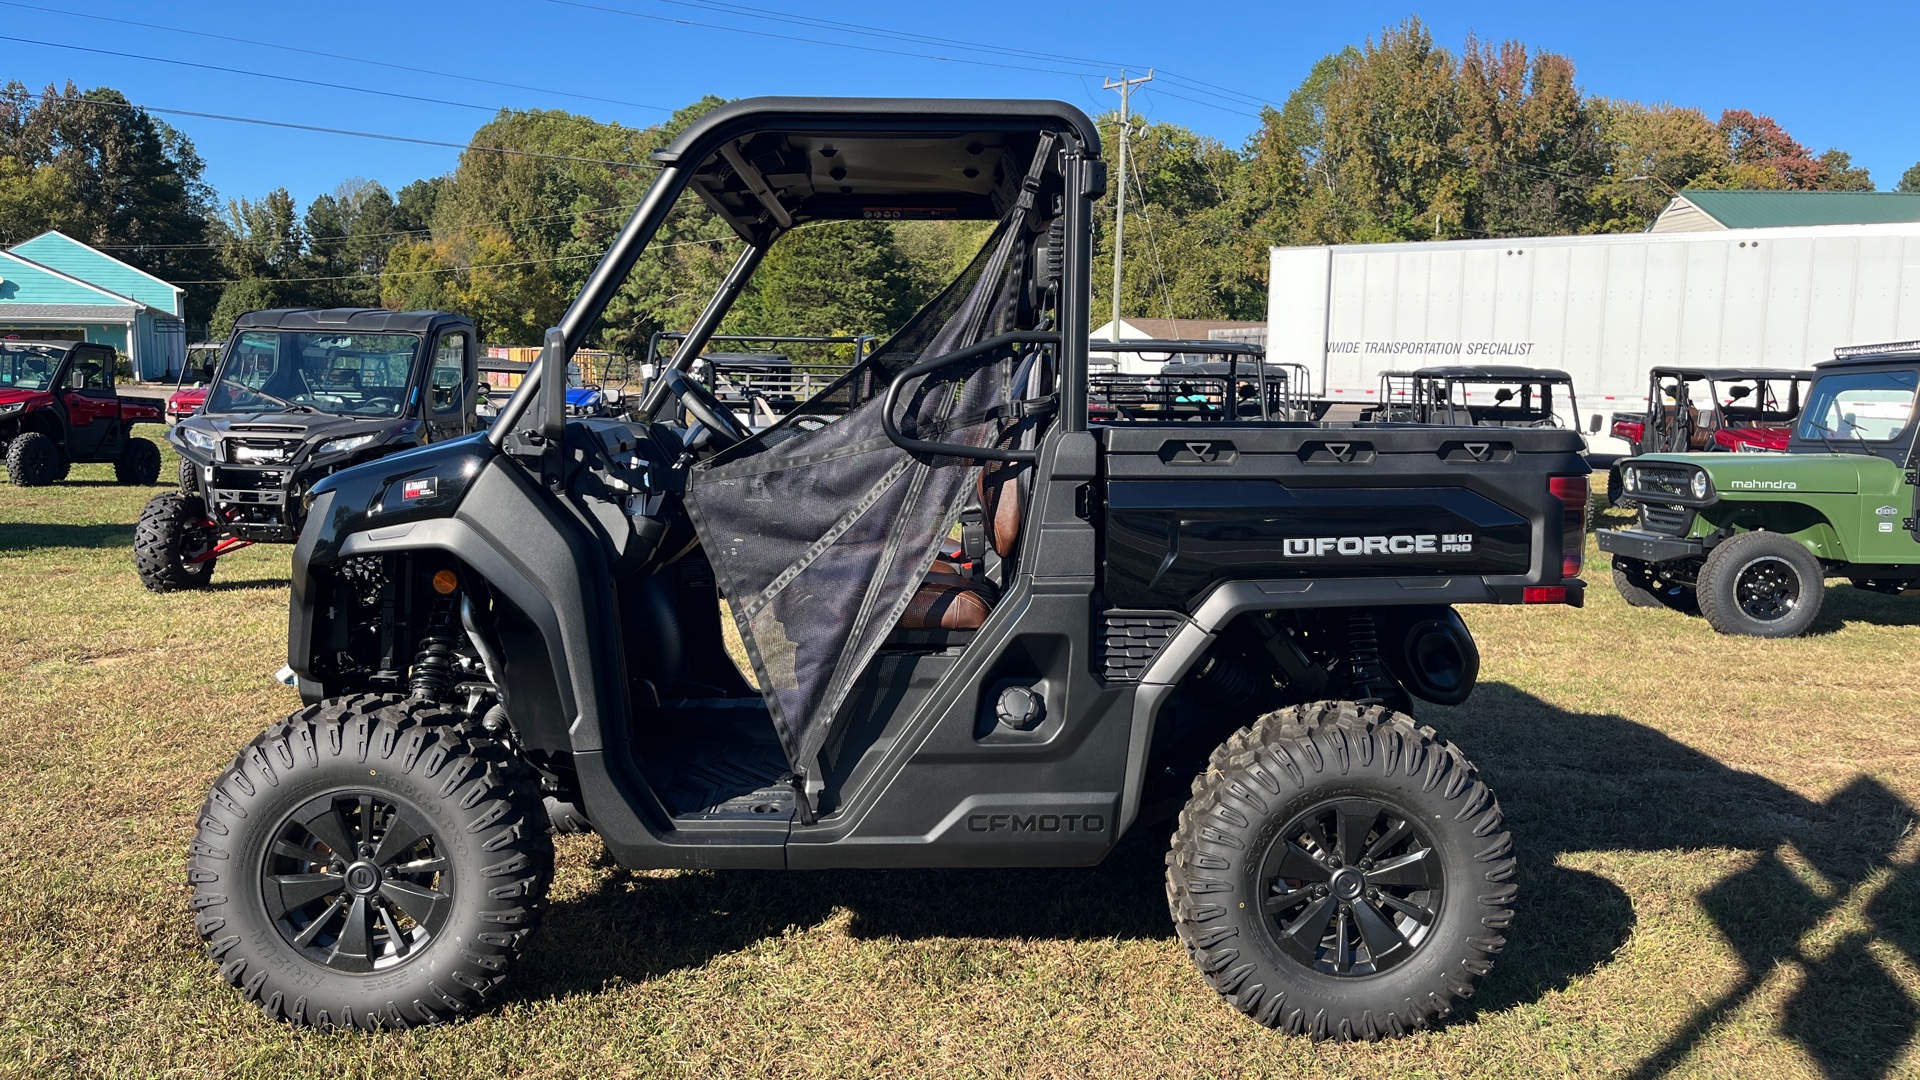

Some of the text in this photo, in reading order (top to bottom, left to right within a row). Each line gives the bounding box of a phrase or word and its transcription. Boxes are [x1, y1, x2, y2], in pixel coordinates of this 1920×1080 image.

[1364, 342, 1463, 354] TRANSPORTATION
[1466, 342, 1535, 355] SPECIALIST
[238, 447, 284, 459] wasaki
[1731, 479, 1797, 489] mahindra
[1283, 534, 1473, 557] UFORCE U10
[1442, 544, 1473, 553] PRO
[1286, 785, 1326, 814] PRO
[968, 814, 1105, 833] CFMOTO
[442, 816, 469, 857] PRO
